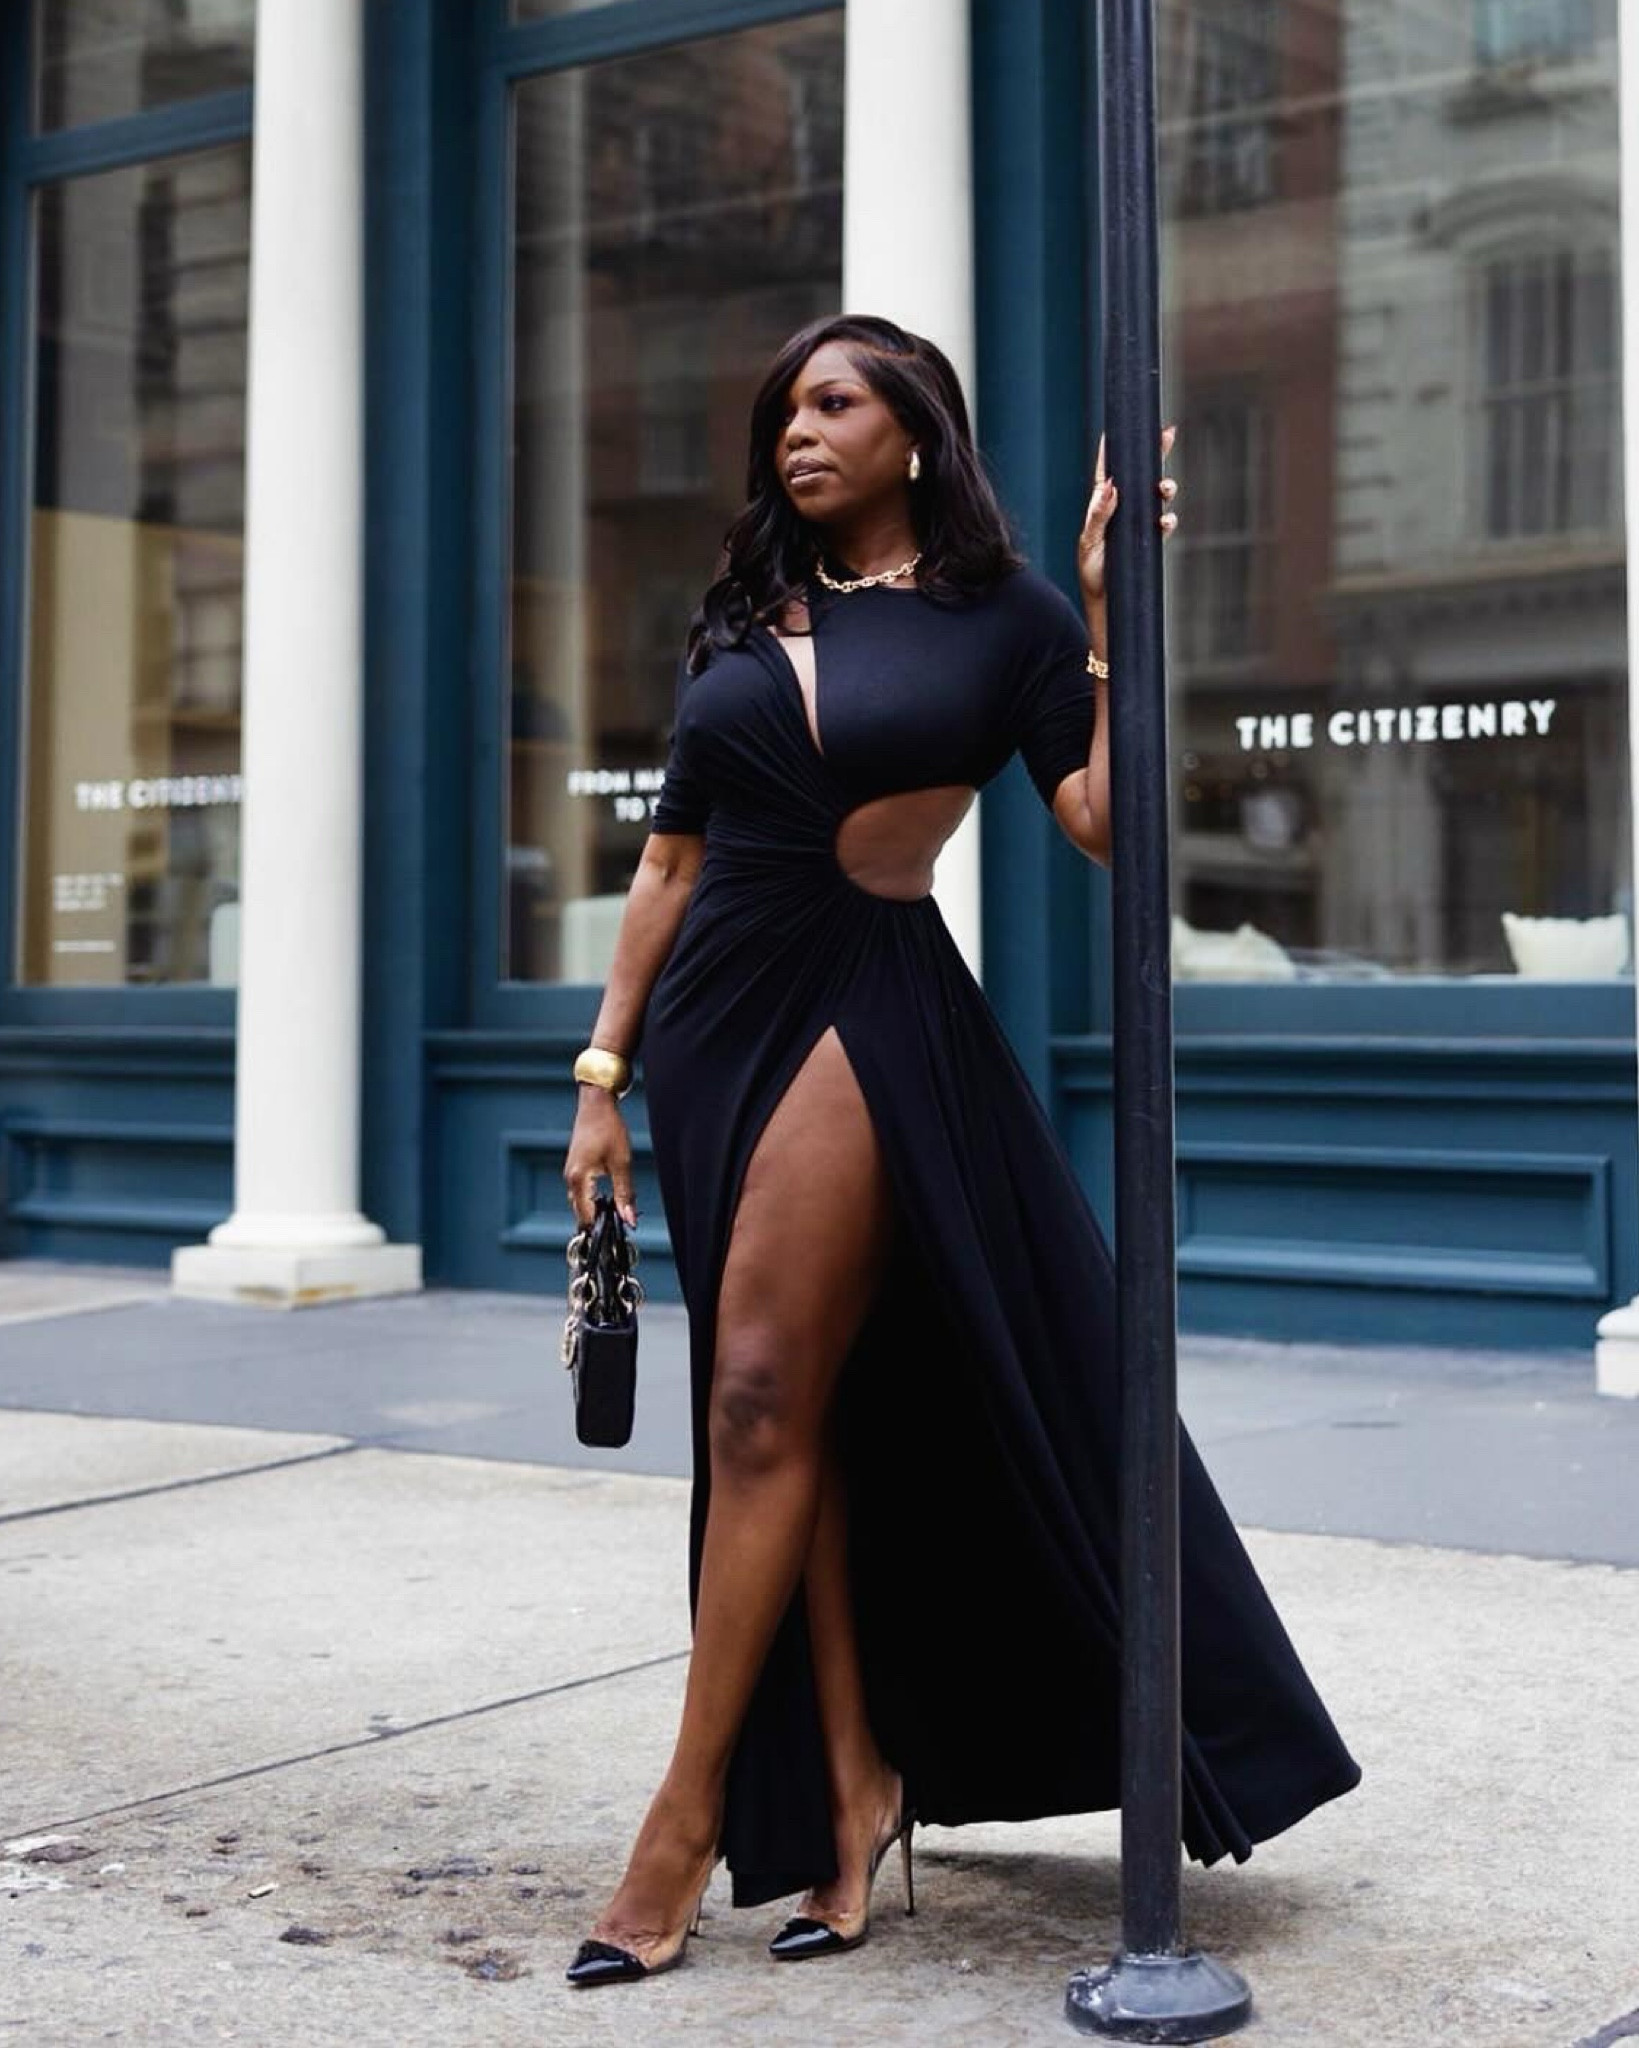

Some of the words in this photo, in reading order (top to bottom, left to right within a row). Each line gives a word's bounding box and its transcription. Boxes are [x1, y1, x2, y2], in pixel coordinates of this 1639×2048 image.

[1236, 713, 1313, 750] THE
[1328, 699, 1557, 746] CITIZENRY
[76, 780, 123, 810] THE
[567, 769, 631, 797] FROM
[614, 796, 646, 822] TO
